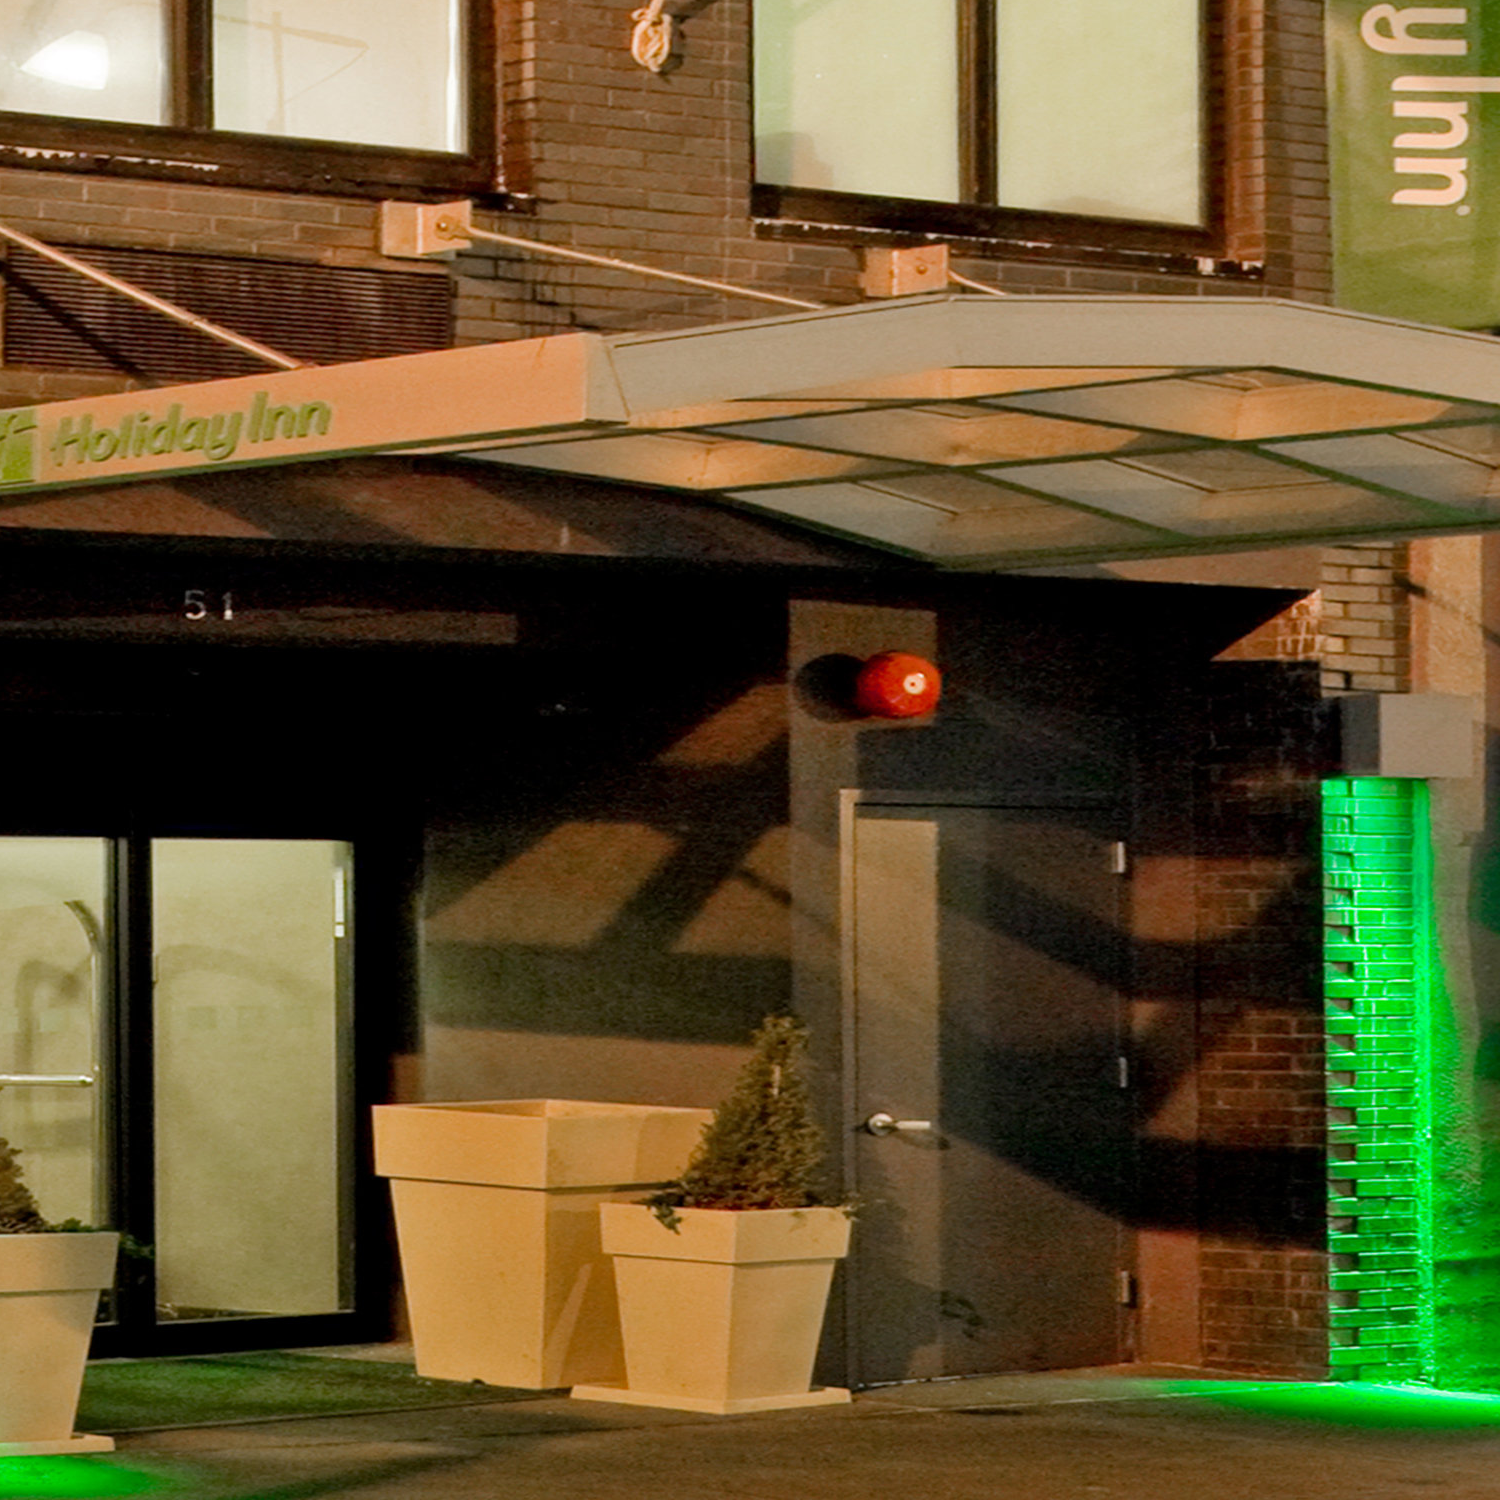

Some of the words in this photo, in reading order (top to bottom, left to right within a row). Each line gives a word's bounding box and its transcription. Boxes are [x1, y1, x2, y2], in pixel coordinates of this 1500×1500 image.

[49, 403, 243, 466] Holiday
[249, 390, 332, 443] Inn
[184, 589, 232, 620] 51
